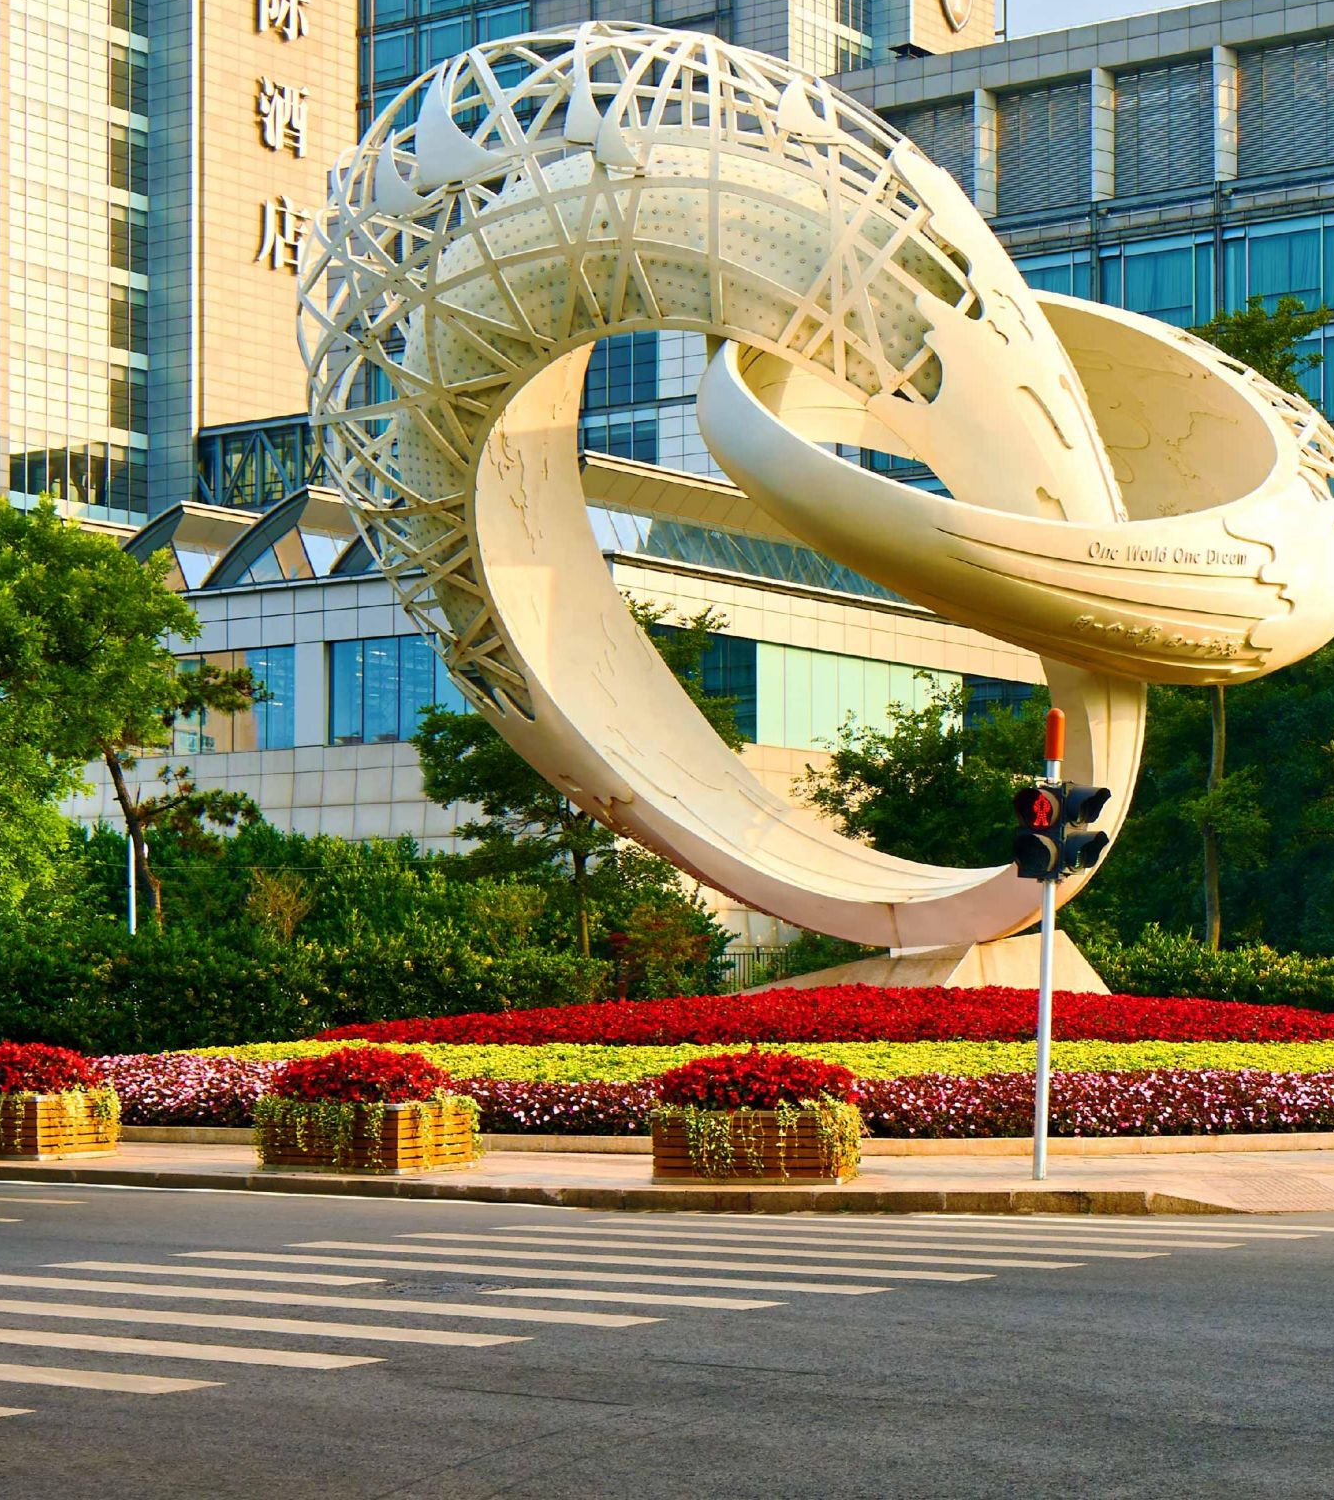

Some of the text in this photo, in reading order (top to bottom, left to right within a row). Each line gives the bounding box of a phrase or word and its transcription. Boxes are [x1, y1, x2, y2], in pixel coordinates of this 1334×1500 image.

[1088, 541, 1119, 561] One
[1126, 544, 1167, 563] World
[1173, 547, 1201, 565] One
